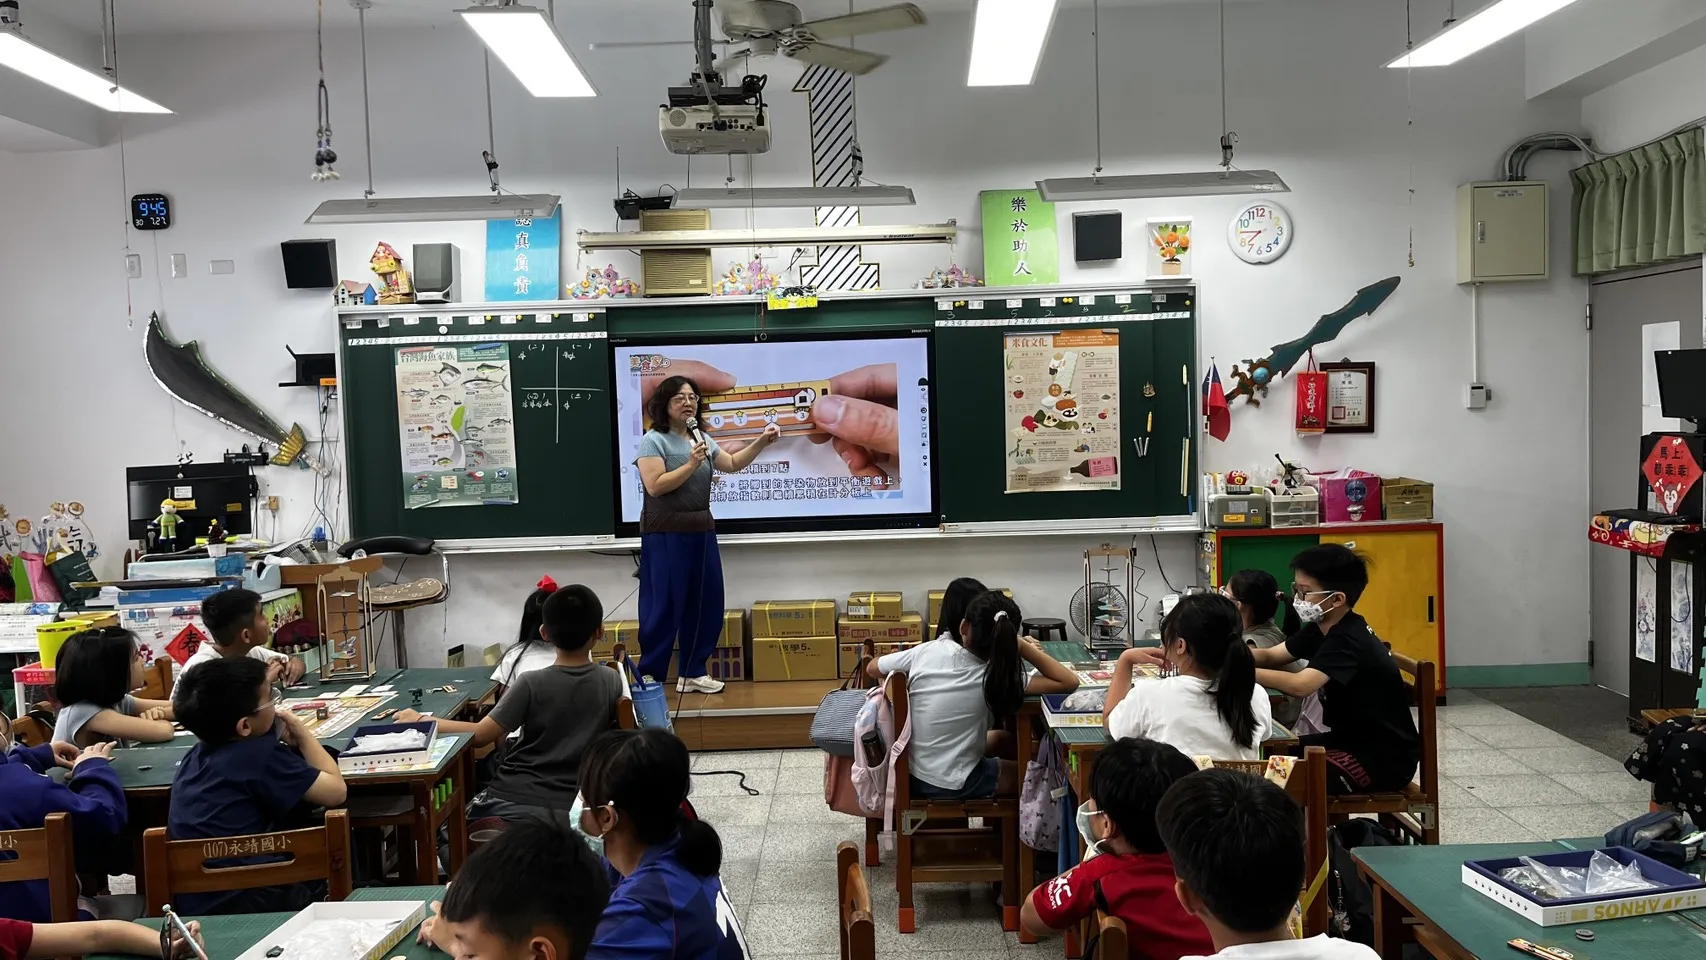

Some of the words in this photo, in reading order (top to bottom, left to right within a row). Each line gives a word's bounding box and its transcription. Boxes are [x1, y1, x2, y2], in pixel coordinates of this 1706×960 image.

[1248, 211, 1255, 220] 11
[1255, 207, 1266, 217] 12
[1240, 218, 1250, 228] 10
[1010, 196, 1032, 276] 樂於助人
[1277, 226, 1283, 236] 3
[1273, 236, 1280, 245] 4
[1266, 243, 1273, 253] 5
[1012, 337, 1048, 348] 米食文化
[714, 417, 720, 425] 0
[1660, 446, 1680, 459] 馬上
[0, 834, 18, 849] 小
[203, 835, 292, 858] (107)永靖國小
[1593, 898, 1661, 921] ARNOS
